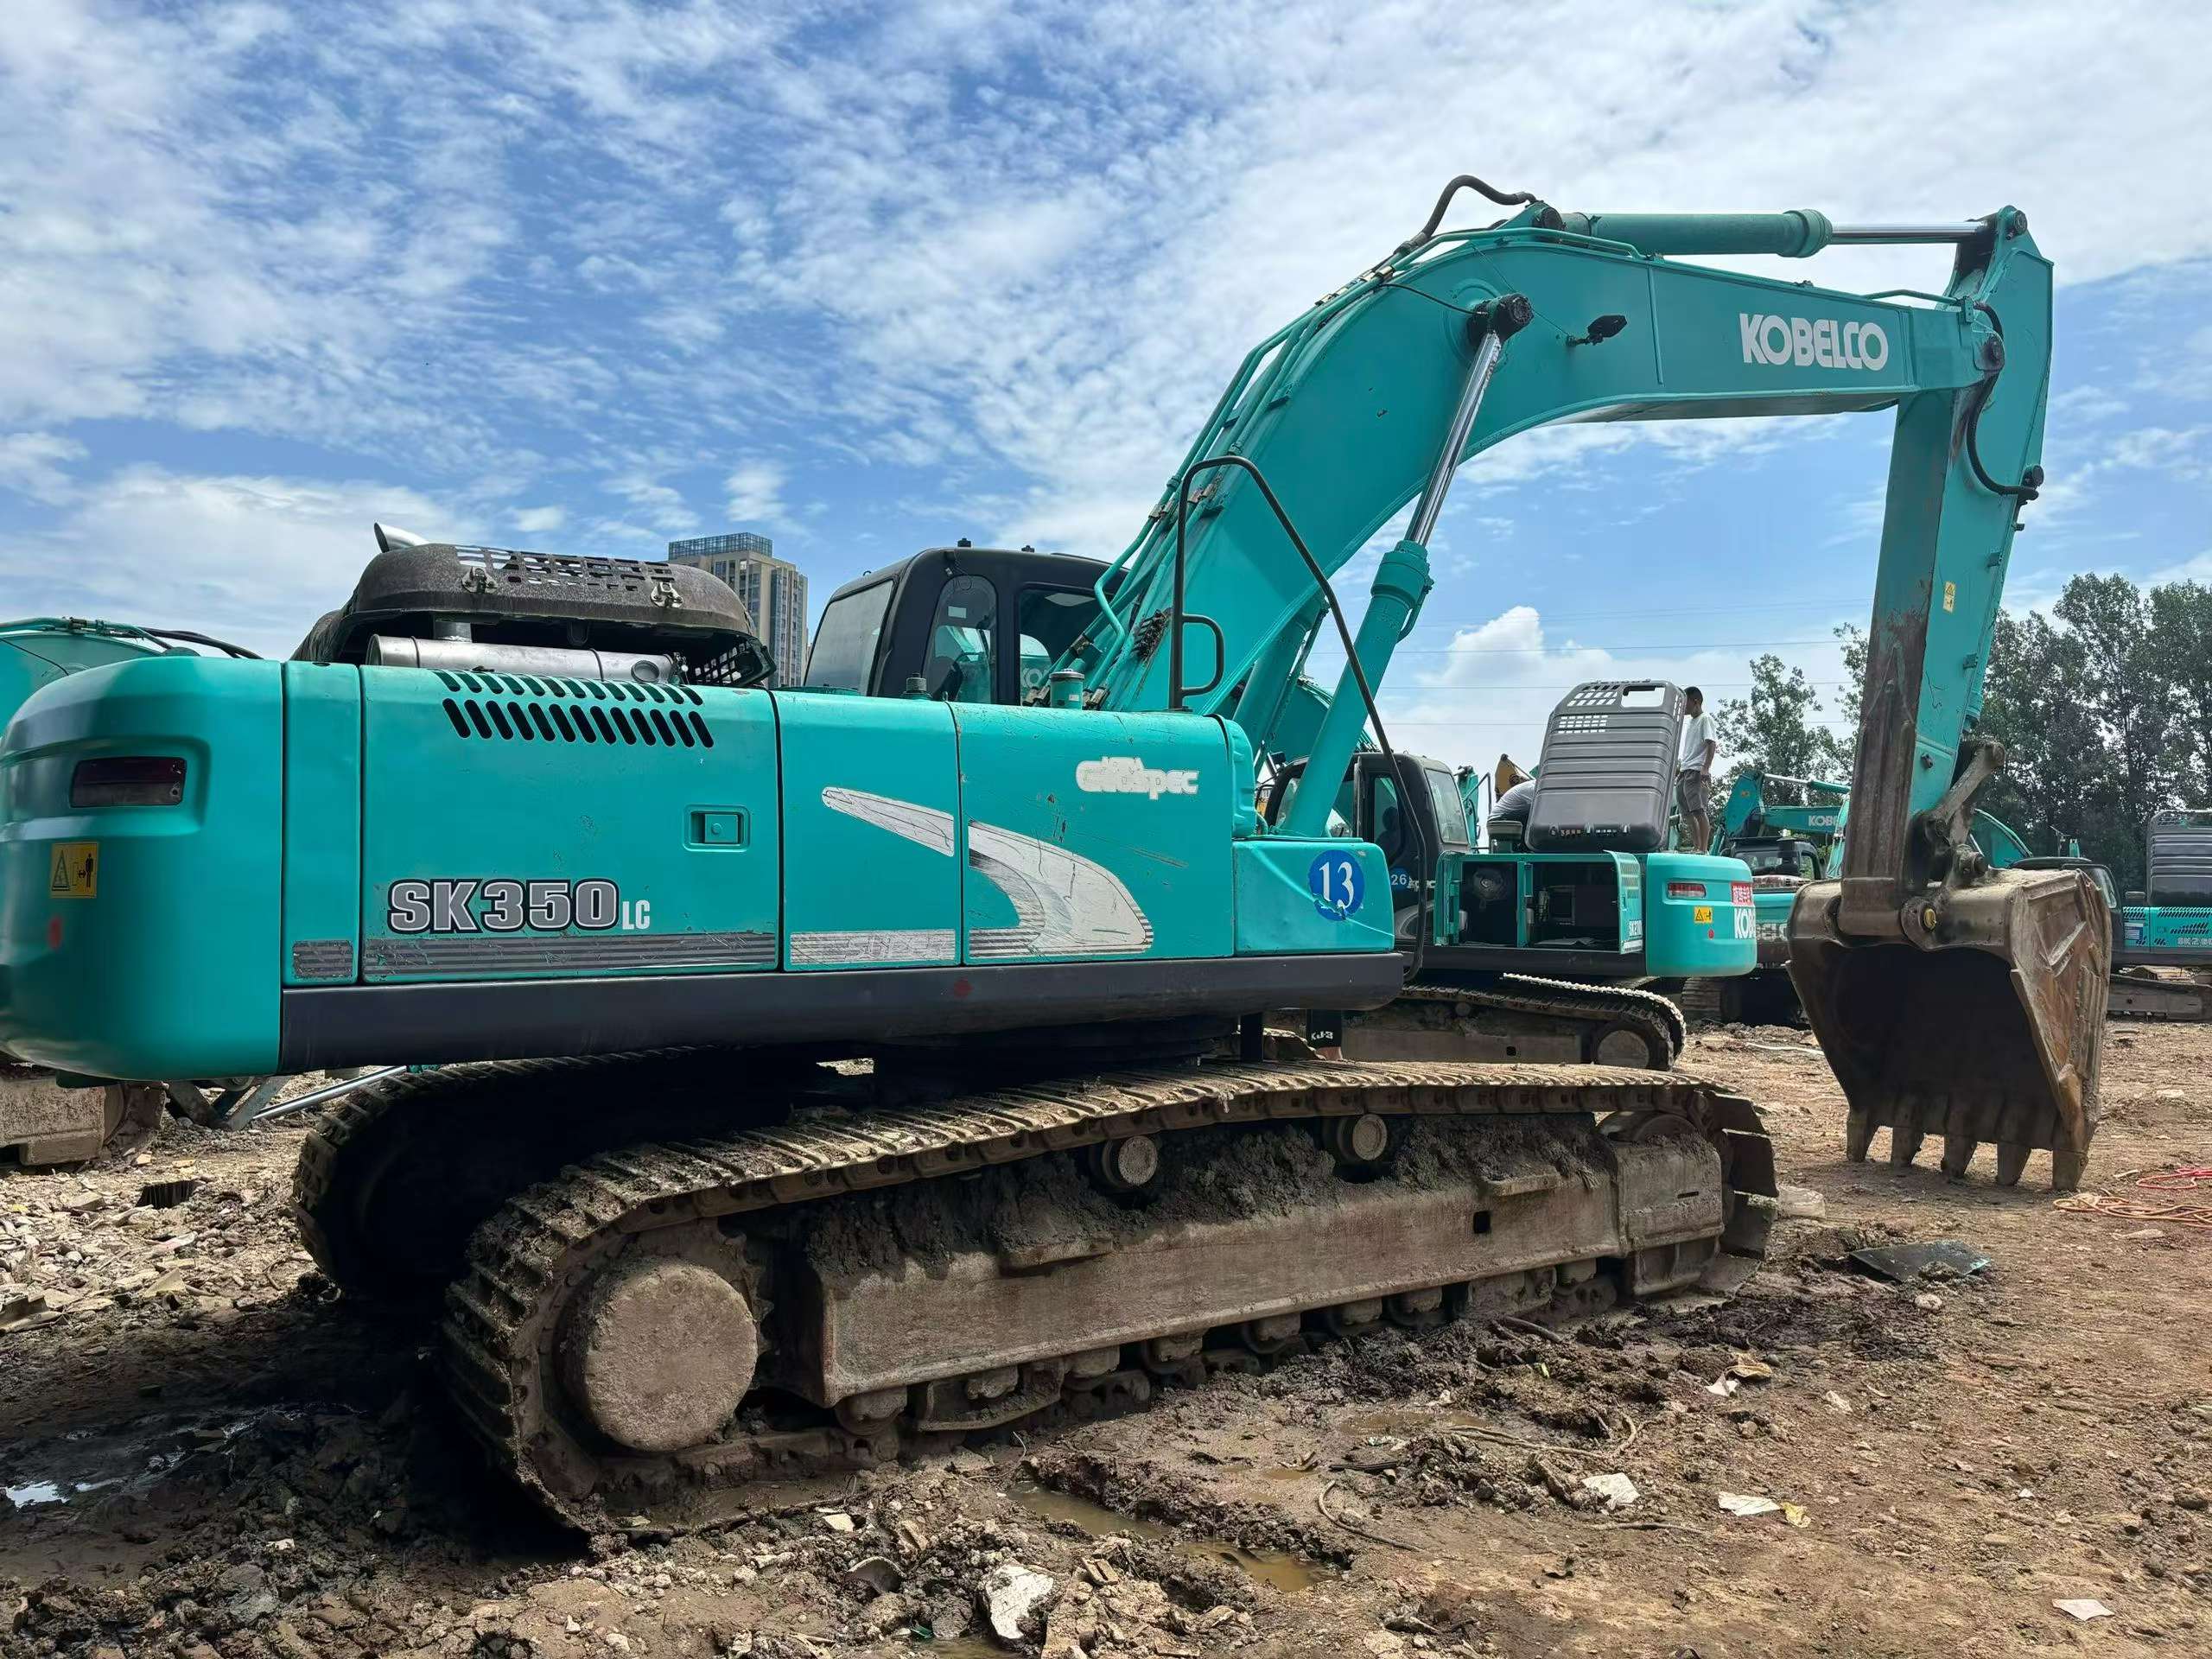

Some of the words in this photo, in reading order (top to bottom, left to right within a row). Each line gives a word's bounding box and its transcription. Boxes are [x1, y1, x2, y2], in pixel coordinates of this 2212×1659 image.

[1739, 313, 1889, 371] KOBELCO
[389, 878, 620, 934] SK350
[622, 899, 651, 930] LC
[1319, 861, 1354, 910] 13
[1390, 874, 1408, 886] 26
